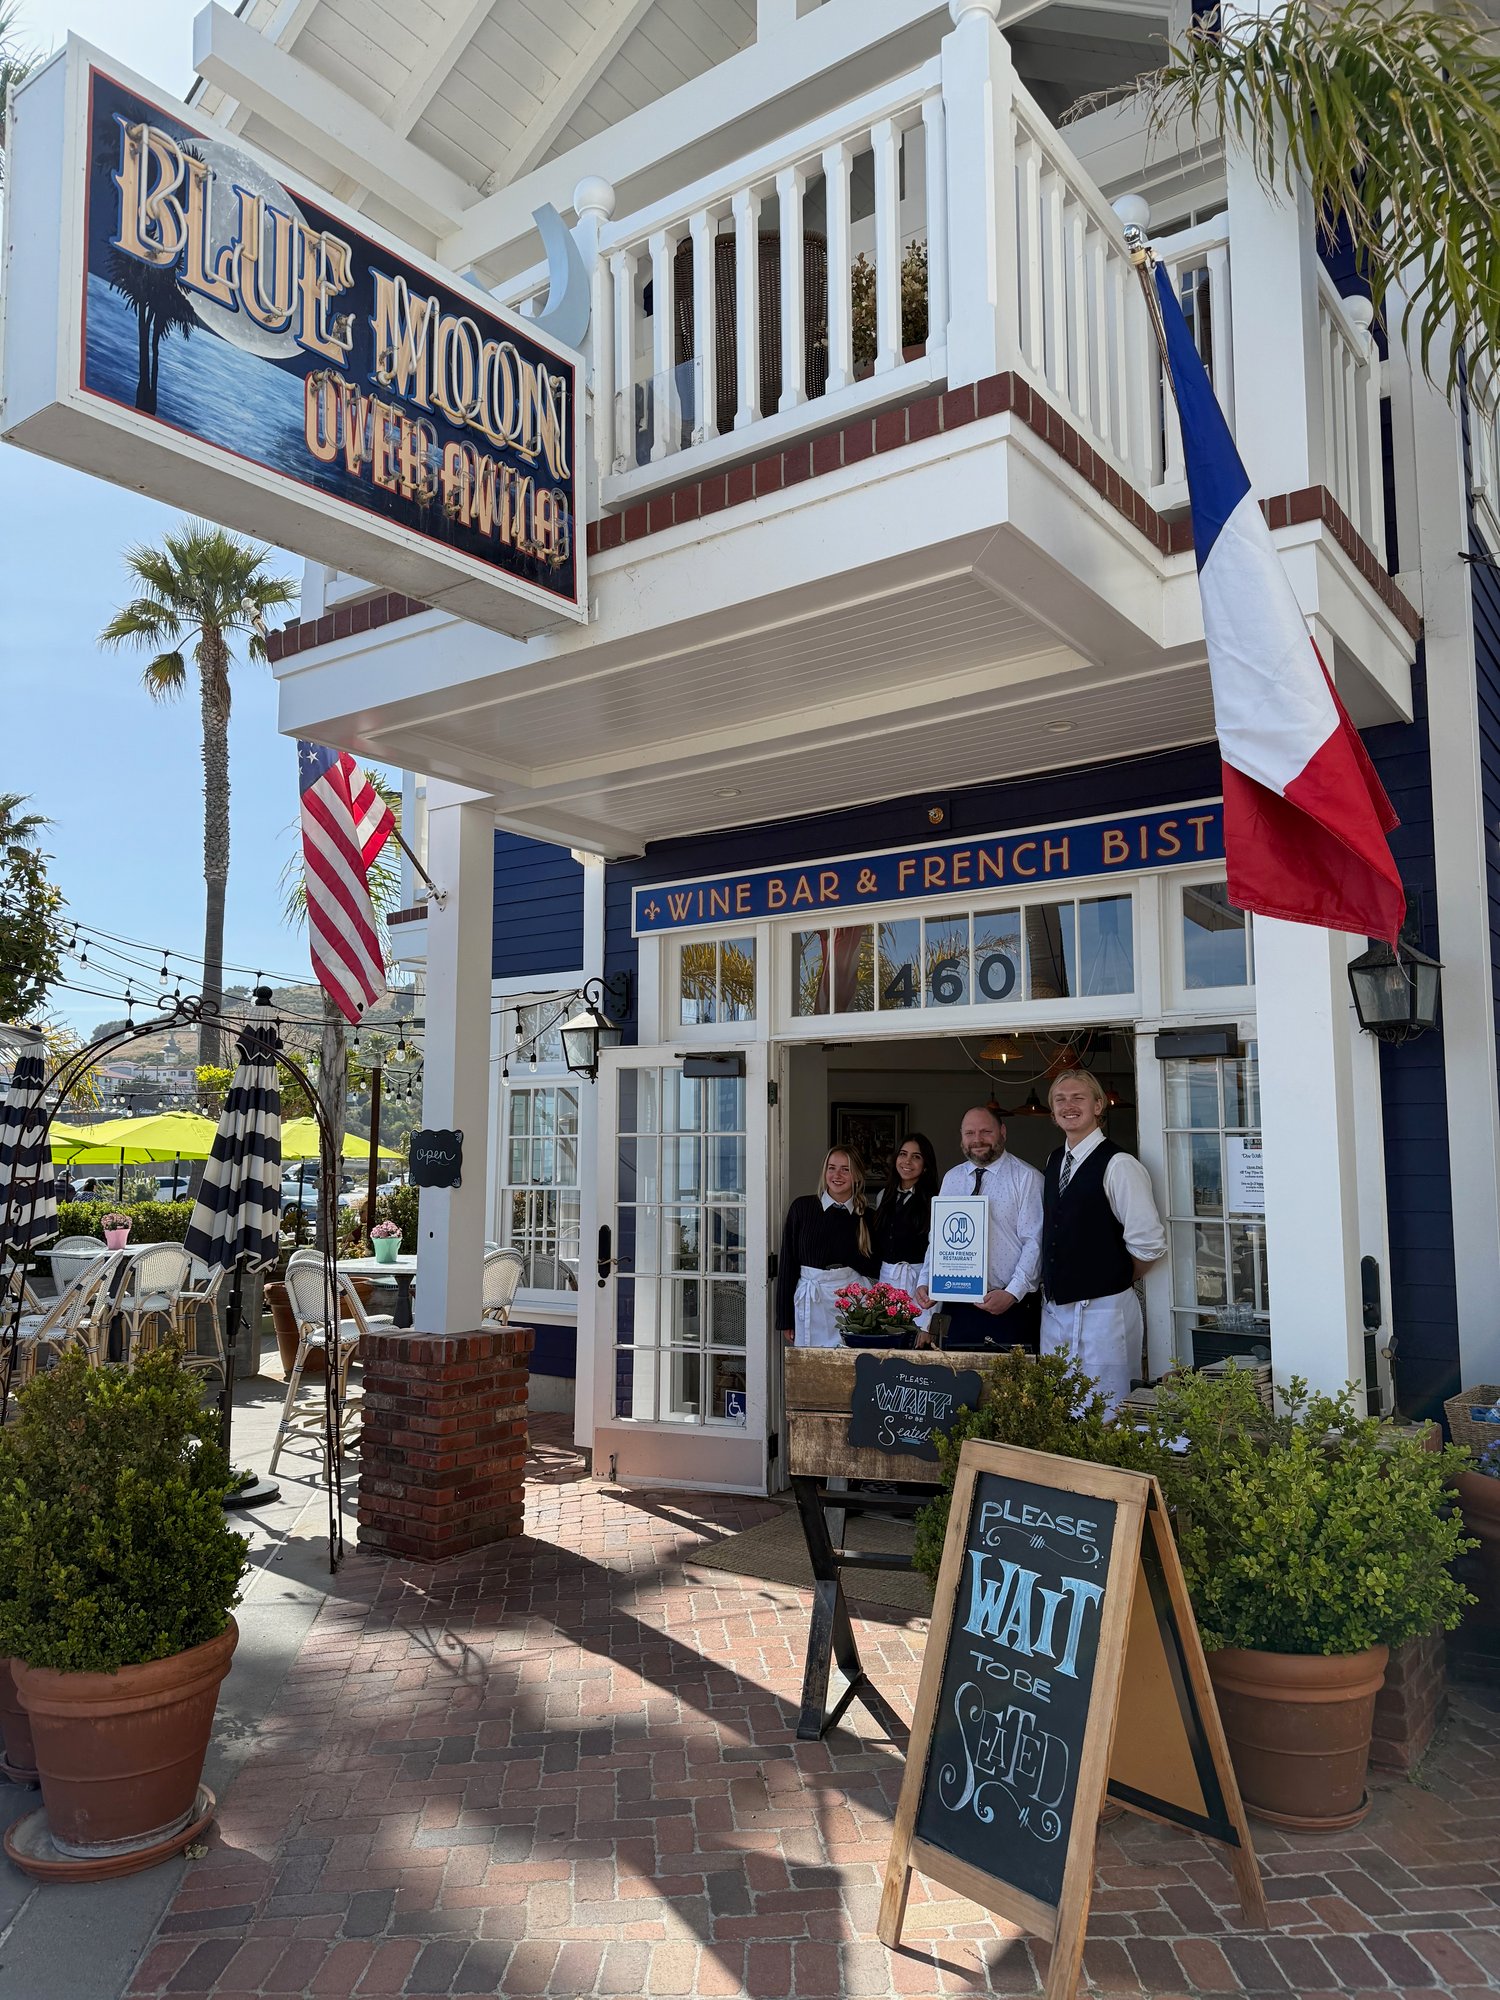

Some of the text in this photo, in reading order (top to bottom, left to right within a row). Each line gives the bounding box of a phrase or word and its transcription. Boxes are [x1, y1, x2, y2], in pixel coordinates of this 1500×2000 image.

[110, 113, 572, 484] BLUE MOON
[304, 368, 569, 563] OVER AVILA
[667, 883, 752, 922] WINE
[767, 871, 840, 909] BAR
[856, 868, 878, 894] &
[898, 837, 1071, 892] FRENCH
[884, 953, 1016, 1007] 460
[416, 1148, 456, 1165] open
[875, 1382, 952, 1420] WAIT
[899, 1373, 930, 1386] PLEASE
[877, 1415, 932, 1446] Seated
[979, 1499, 1098, 1543] PLEASE
[962, 1549, 1106, 1680] WAIT
[938, 1681, 1070, 1812] SEATED
